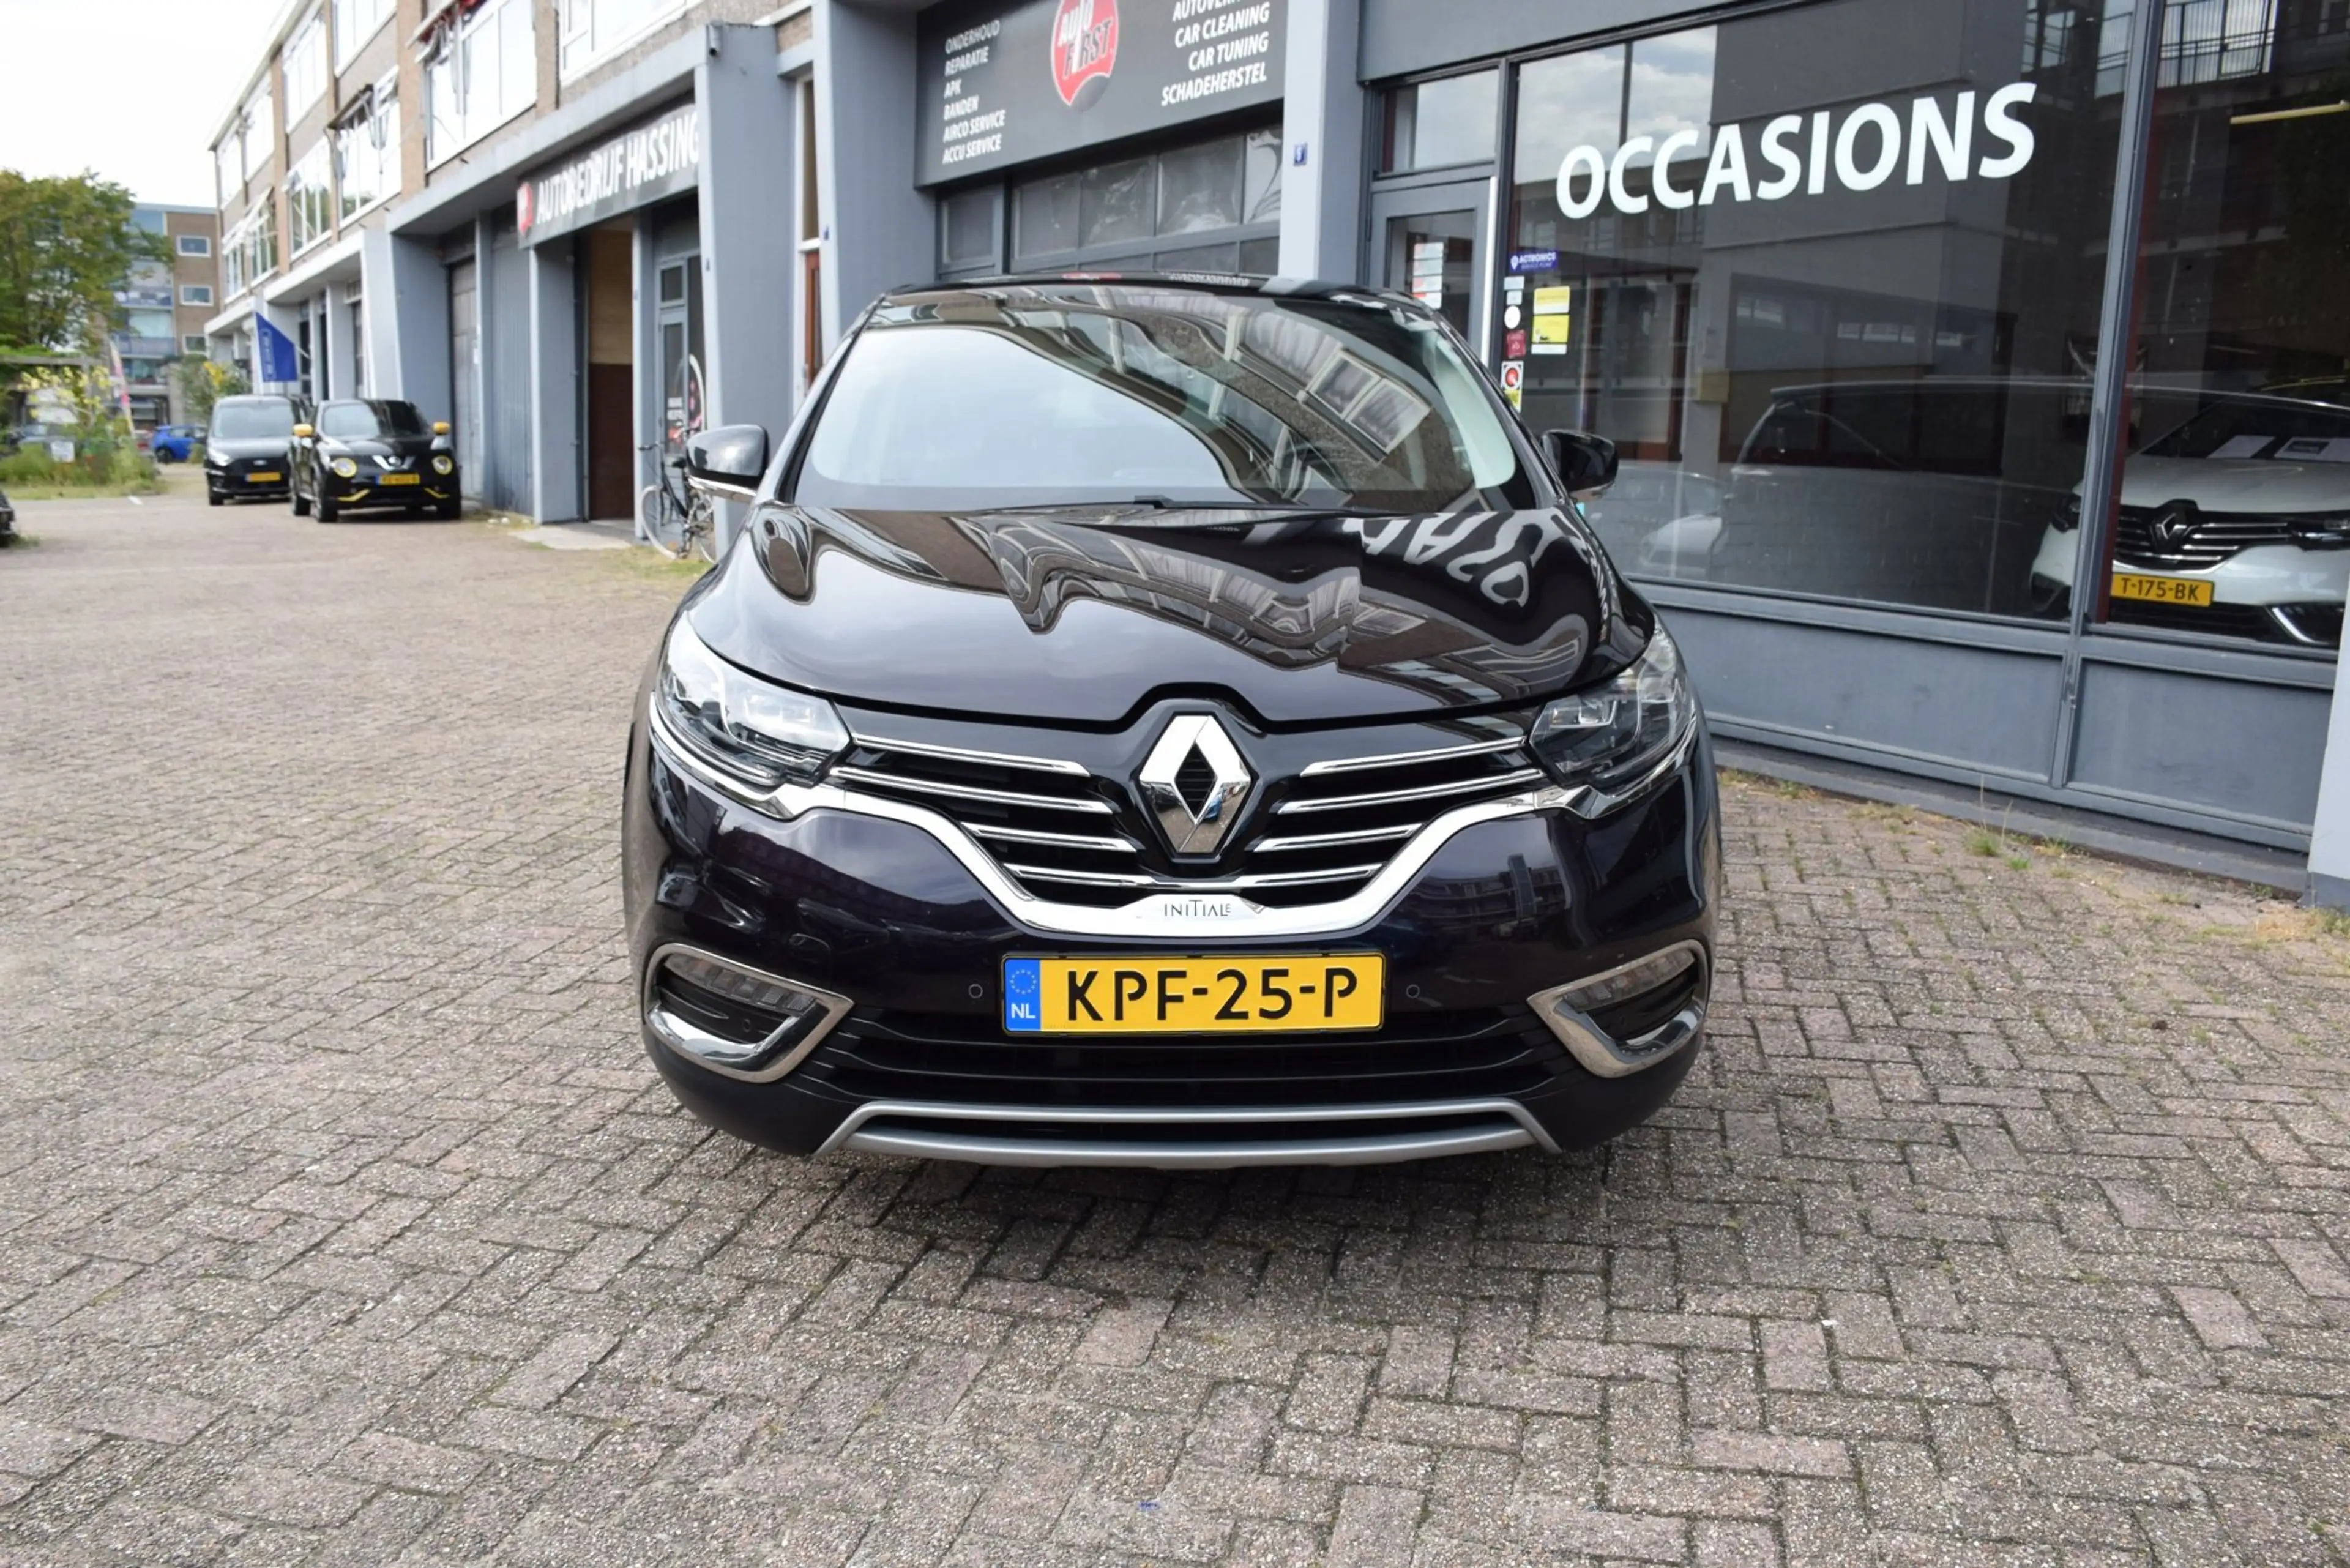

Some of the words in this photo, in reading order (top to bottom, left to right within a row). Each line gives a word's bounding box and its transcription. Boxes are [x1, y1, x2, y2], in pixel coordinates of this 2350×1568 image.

[945, 20, 1000, 54] ONDERHOUD
[1058, 0, 1094, 47] AUTO
[1175, 23, 1200, 48] CAR
[1203, 2, 1270, 40] CLEANING
[944, 46, 989, 77] REPARATIE
[1062, 17, 1113, 78] FIRST
[1188, 47, 1215, 72] CAR
[1217, 31, 1269, 64] TUNING
[944, 78, 961, 99] APK
[1161, 62, 1267, 106] SCHADEHERSTEL
[944, 94, 979, 121] BANDEN
[943, 120, 969, 143] AIRCO
[969, 109, 1005, 135] SERVICE
[942, 144, 966, 165] ACCU
[966, 133, 1002, 159] SERVICE
[1556, 82, 2037, 219] OCCASIONS
[536, 144, 624, 225] AUTOBEDRIJF
[2121, 578, 2199, 601] T-175-BK
[1165, 899, 1231, 917] INITIALE
[1067, 967, 1358, 1021] KPF-25-P
[1011, 1003, 1036, 1020] NL
